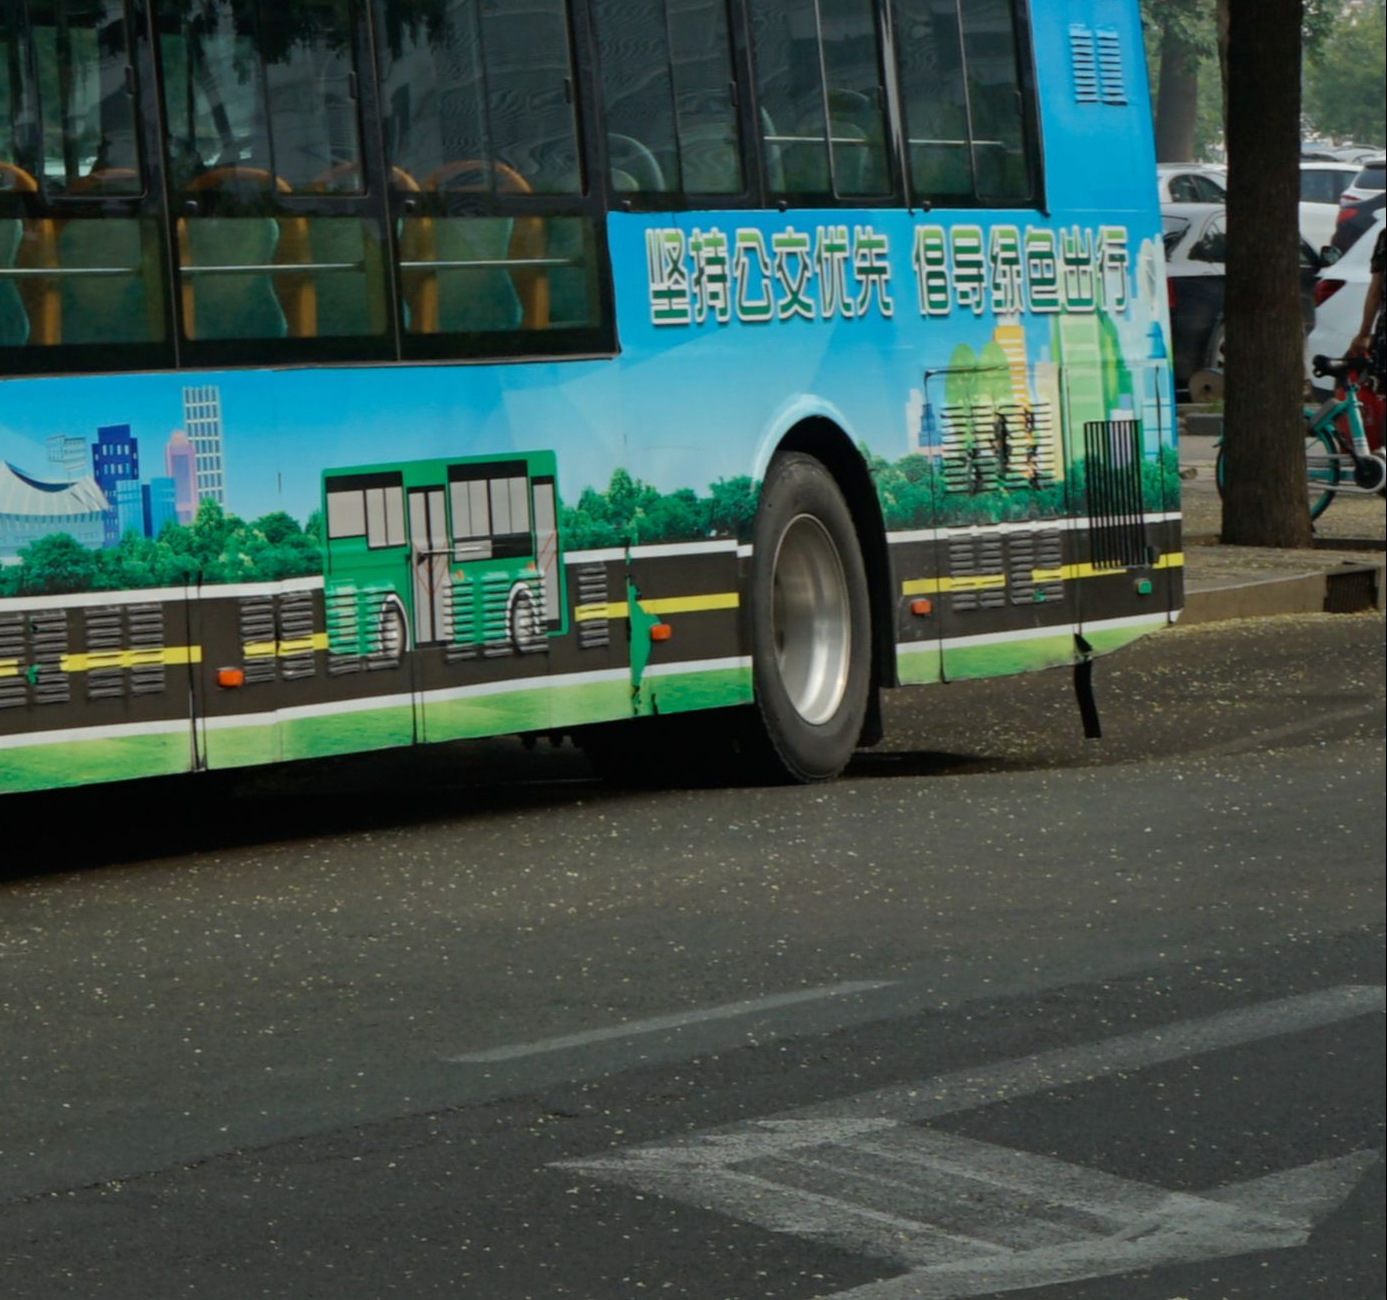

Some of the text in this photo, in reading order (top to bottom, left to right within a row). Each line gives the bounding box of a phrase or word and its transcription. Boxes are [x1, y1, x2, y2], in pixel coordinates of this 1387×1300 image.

[644, 223, 1129, 326] 坚持公交优先 倡导绿色出行
